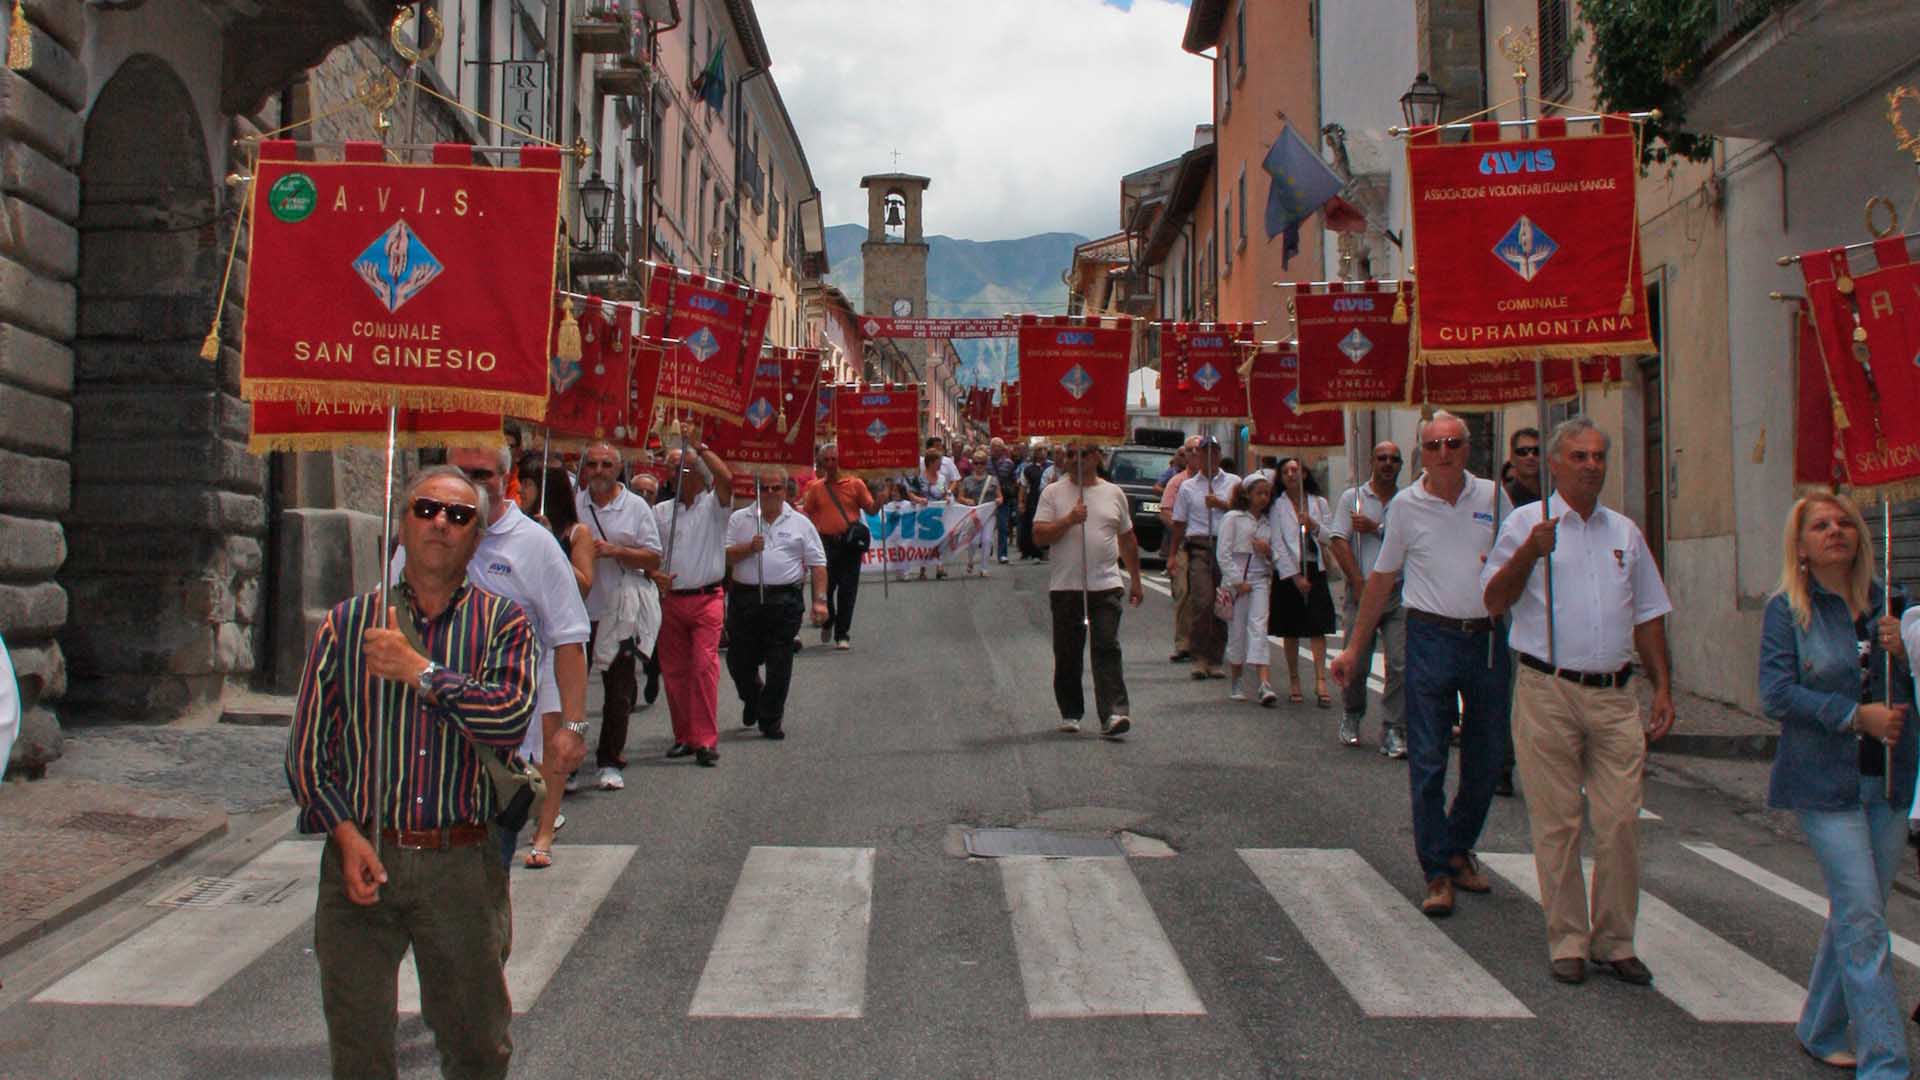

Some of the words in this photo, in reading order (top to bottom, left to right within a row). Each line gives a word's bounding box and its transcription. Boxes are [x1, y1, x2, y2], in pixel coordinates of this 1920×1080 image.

[508, 64, 538, 145] RIS
[1479, 148, 1556, 175] AVIS
[1580, 177, 1617, 192] SANGUE
[1332, 297, 1375, 312] AVIS
[1497, 296, 1569, 312] COMUNALE
[352, 321, 441, 341] COMUNALE
[1439, 315, 1633, 342] CUPRAMONTANA
[295, 341, 353, 363] SAN
[372, 345, 497, 372] GINESIO
